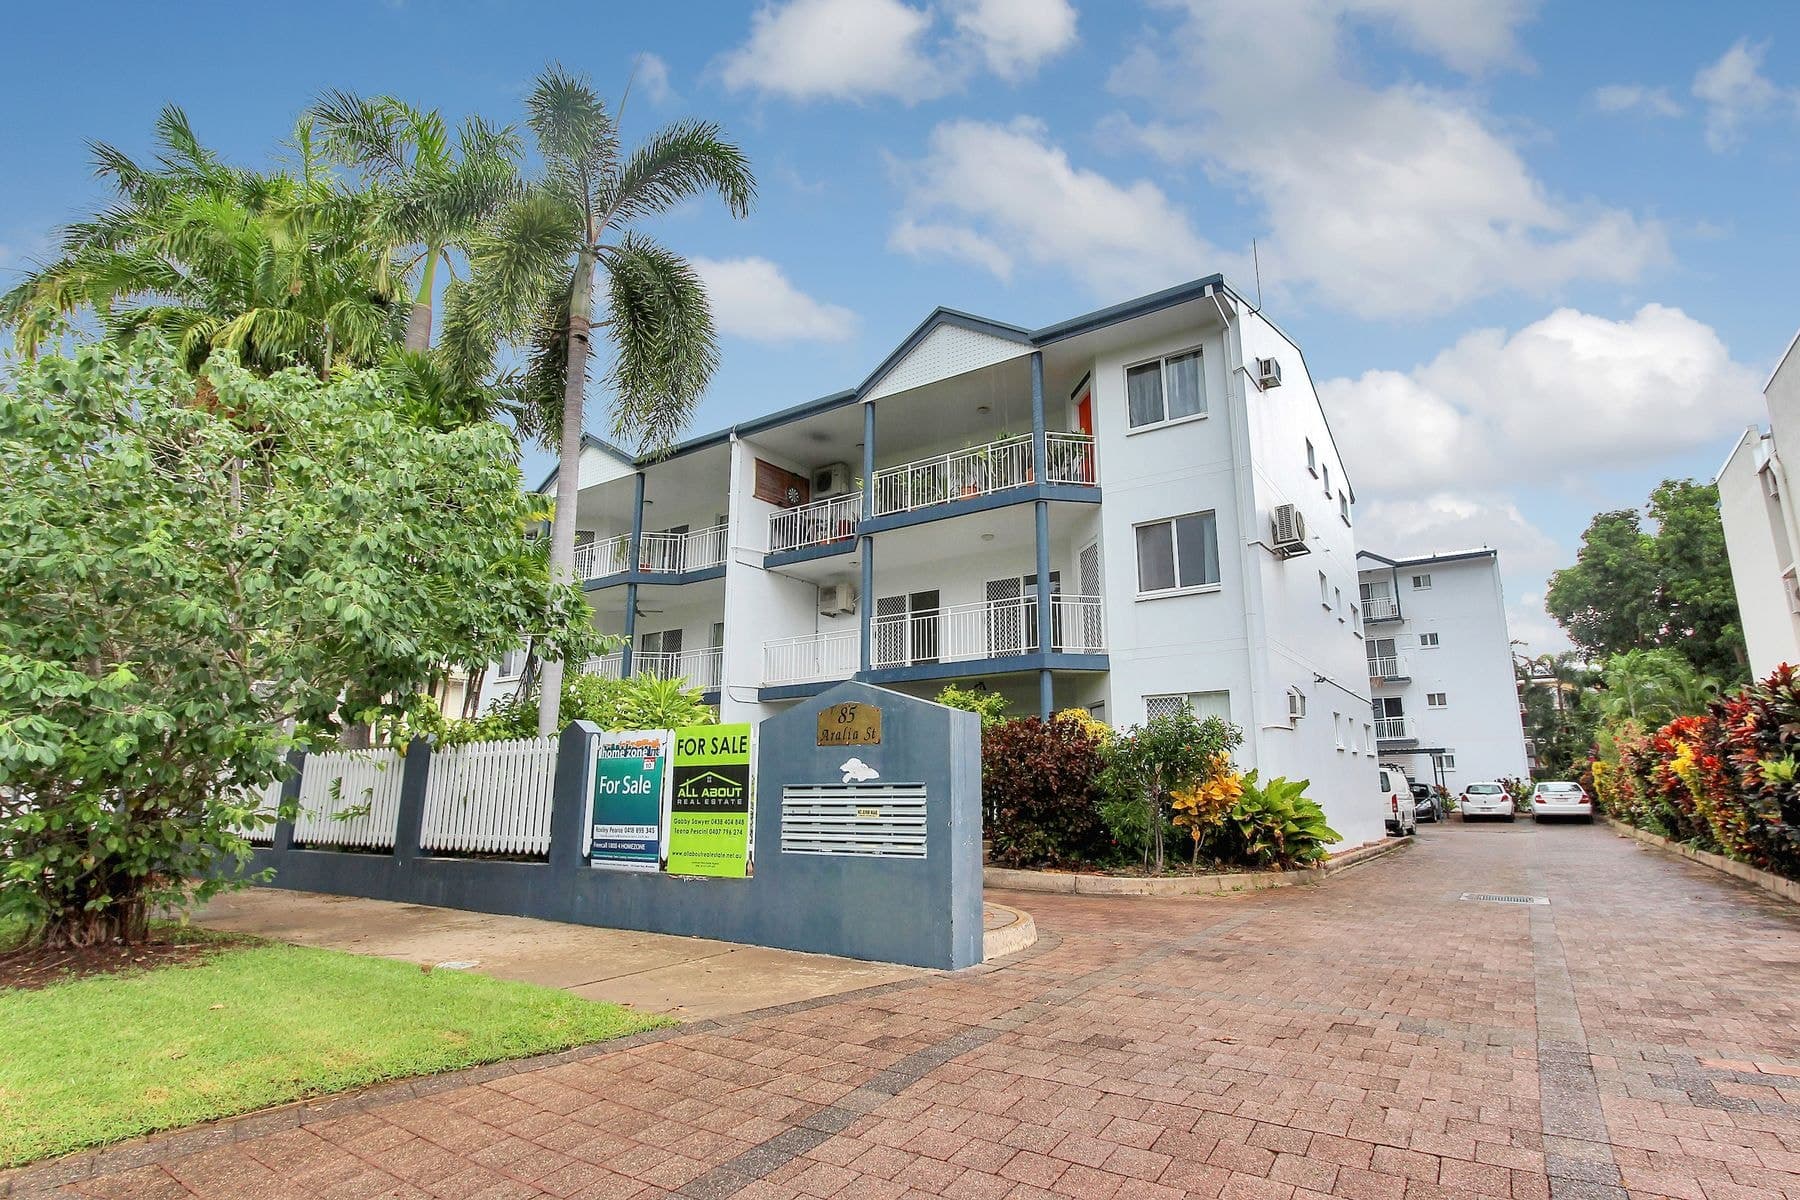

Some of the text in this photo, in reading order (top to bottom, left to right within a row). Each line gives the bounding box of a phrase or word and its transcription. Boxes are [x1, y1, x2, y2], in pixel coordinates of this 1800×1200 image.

[838, 704, 857, 723] 85
[820, 726, 876, 742] Aralia St
[602, 747, 625, 758] home
[627, 747, 648, 758] zone
[677, 735, 748, 756] FOR SALE
[600, 774, 651, 794] For Sale
[677, 779, 743, 798] ALL ABOUT
